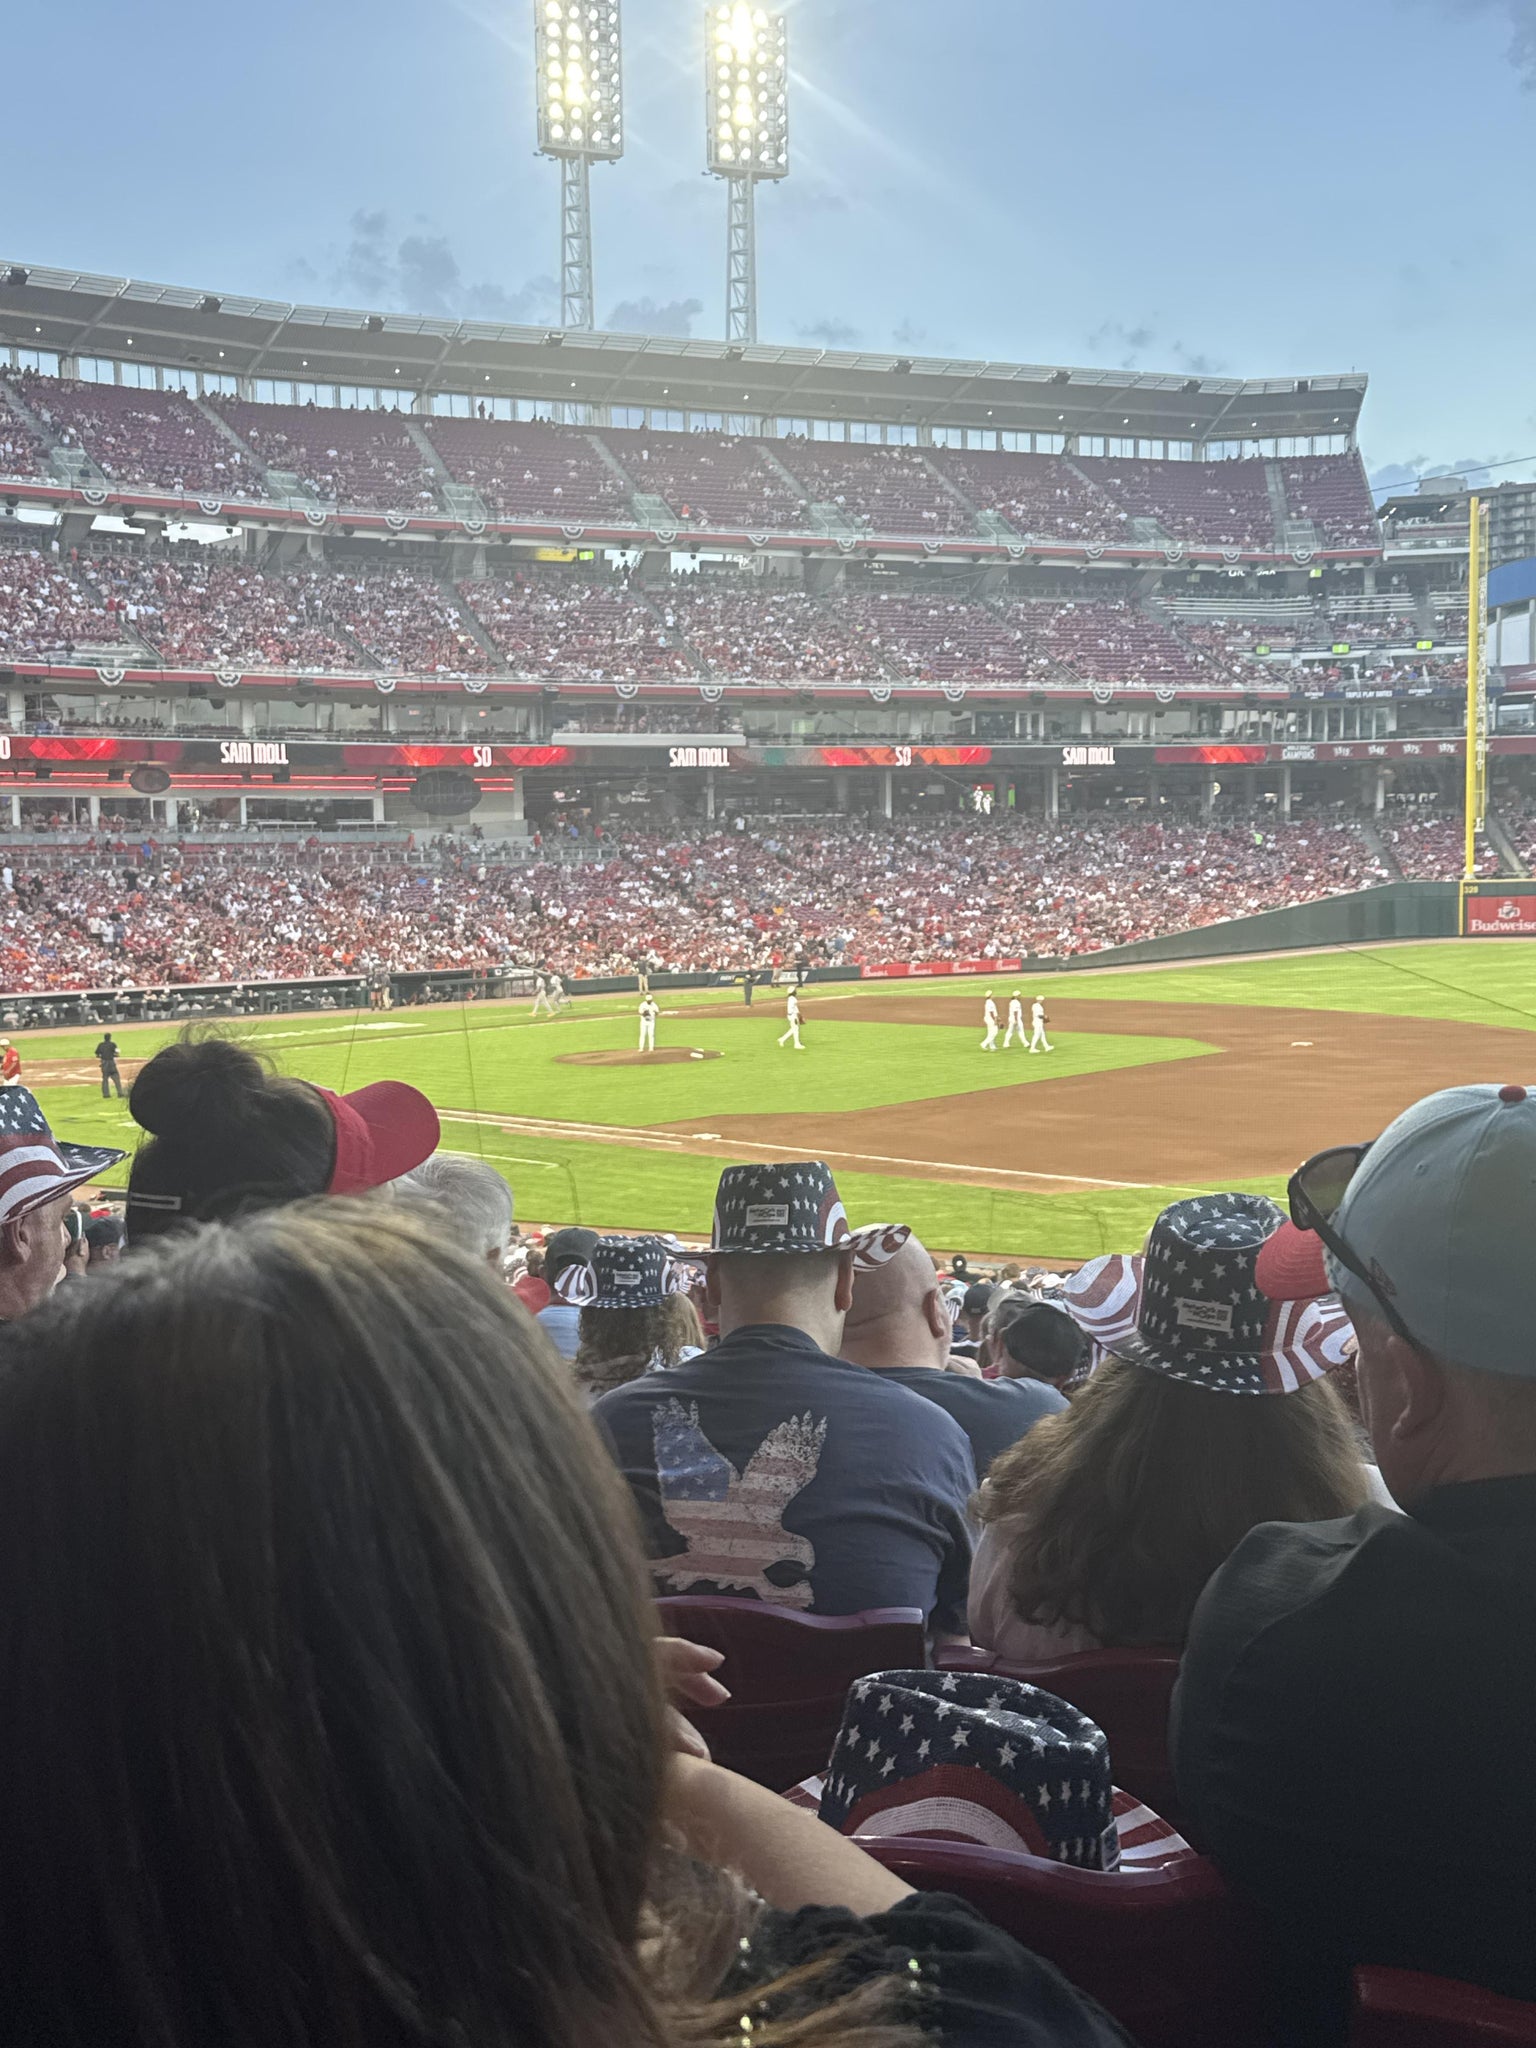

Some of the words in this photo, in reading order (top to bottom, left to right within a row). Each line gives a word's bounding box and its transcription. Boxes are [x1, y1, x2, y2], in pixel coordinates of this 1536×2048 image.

[220, 742, 251, 764] SAM
[253, 742, 289, 765] MOLL
[669, 748, 696, 767] SAM
[697, 748, 730, 767] MOLL
[1062, 747, 1087, 765] SAM
[1088, 747, 1115, 765] MOLL
[1471, 919, 1536, 931] Budweise
